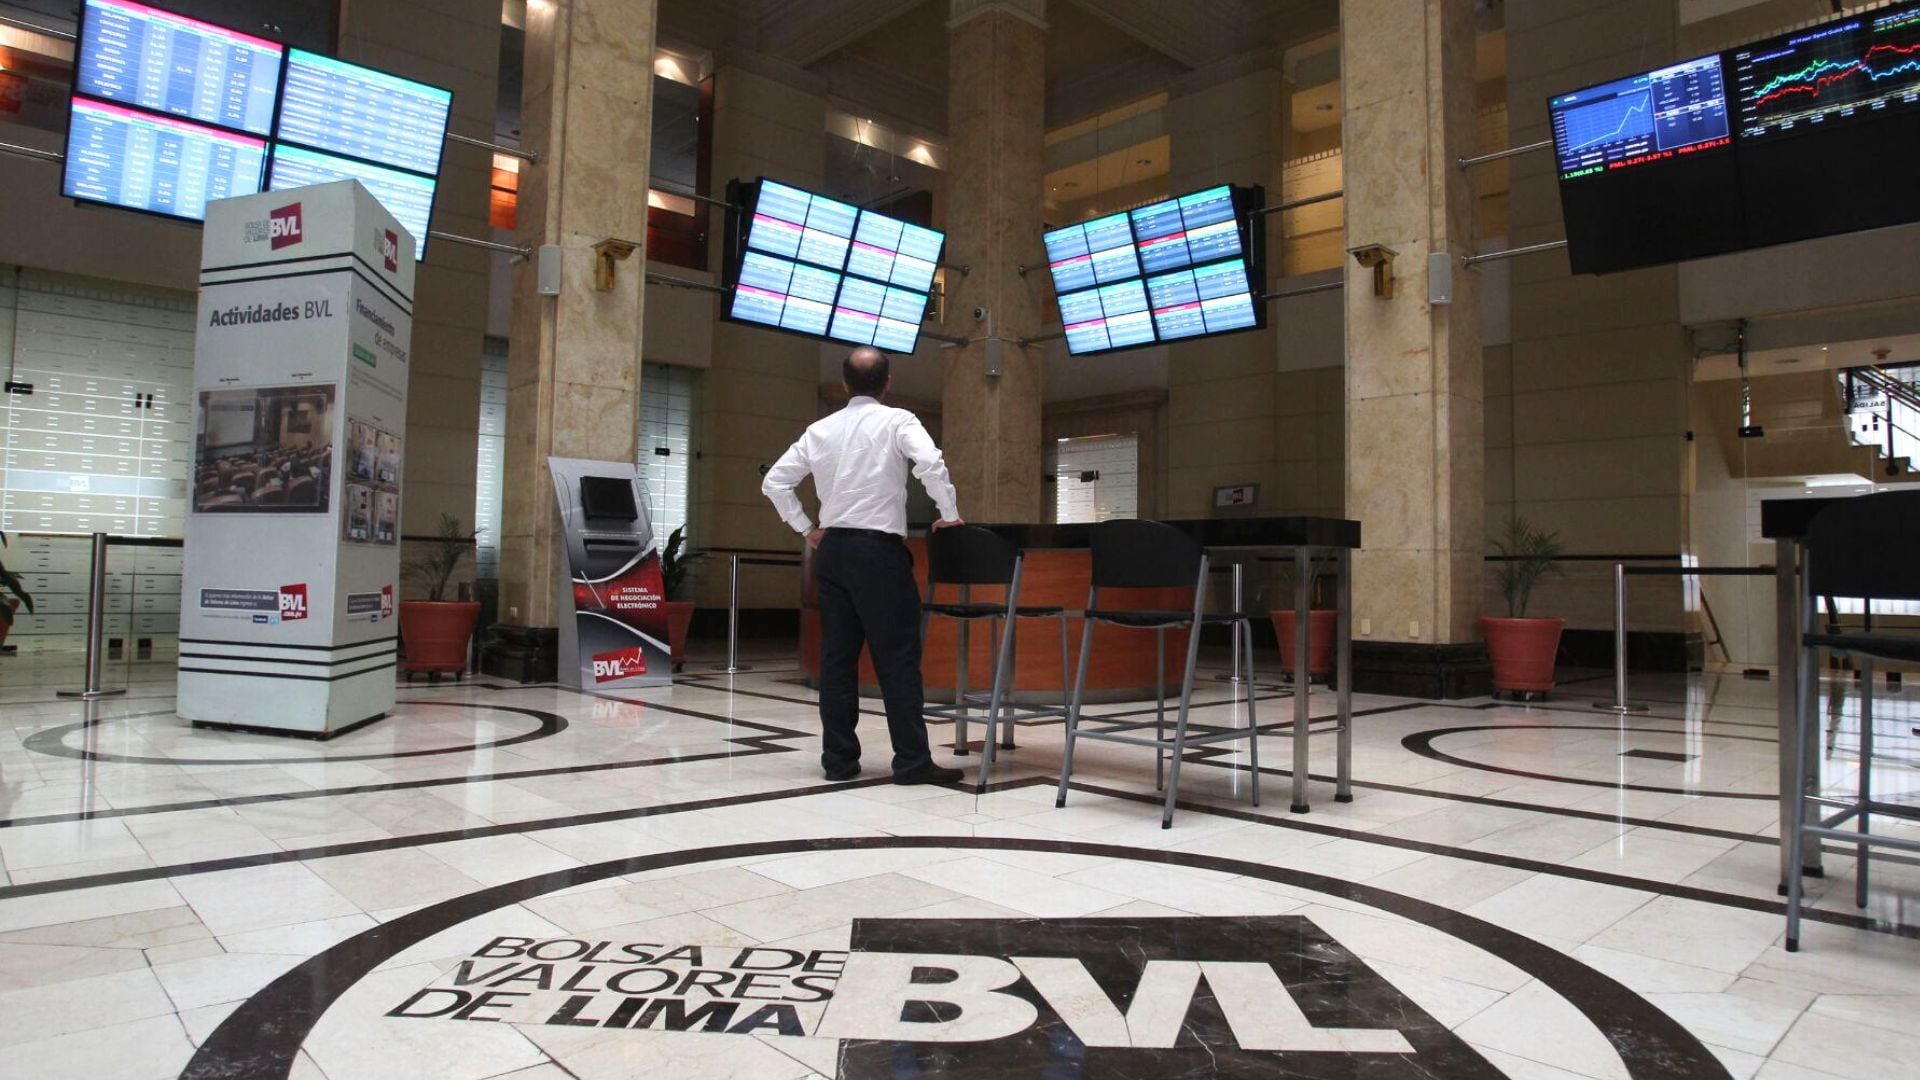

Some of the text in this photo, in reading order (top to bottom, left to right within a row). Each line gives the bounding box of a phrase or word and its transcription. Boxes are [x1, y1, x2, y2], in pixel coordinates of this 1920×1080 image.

[270, 216, 300, 238] BVL
[384, 238, 397, 265] BVL
[209, 299, 333, 327] Actividades BVL
[280, 594, 306, 611] BVL
[592, 660, 624, 676] BVL
[470, 936, 850, 974] BOLSA DE
[453, 960, 839, 1002] VALORES
[383, 988, 806, 1037] DE LIMA
[811, 951, 1418, 1054] BVL
